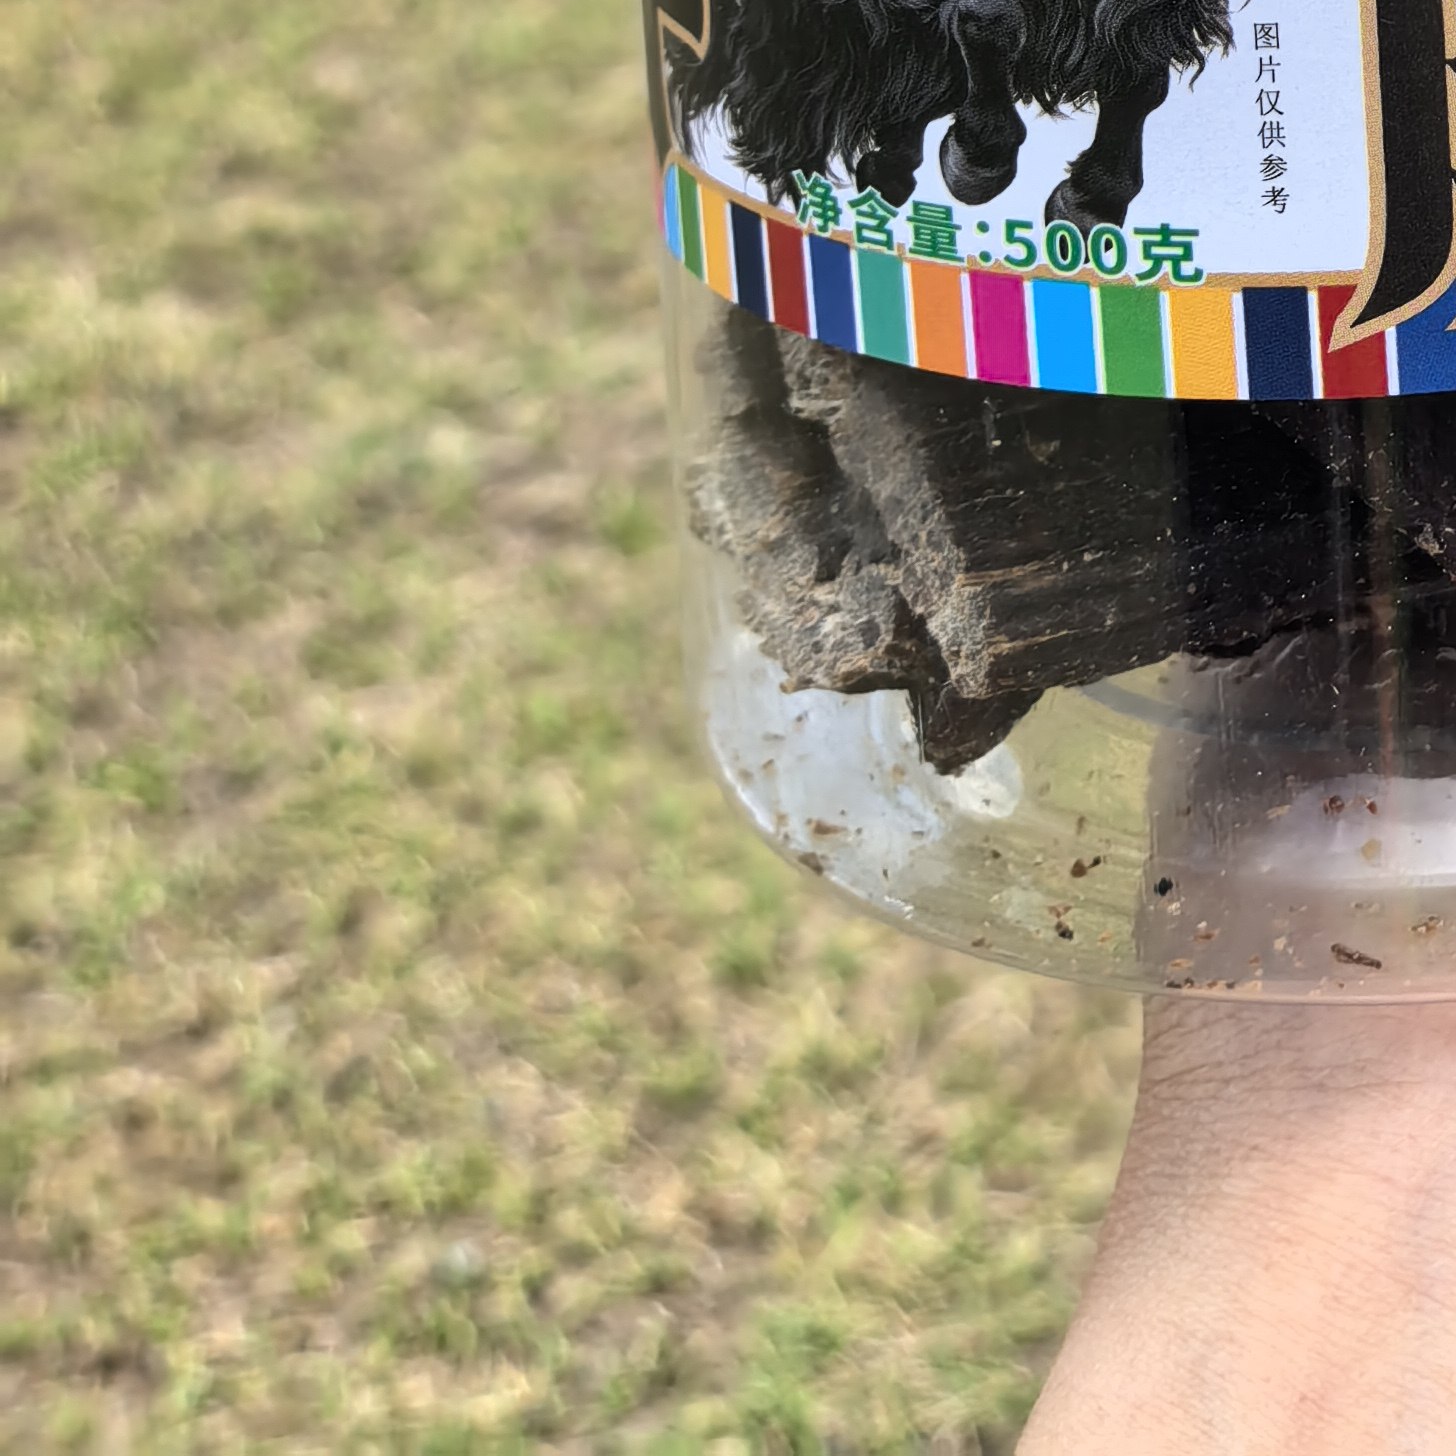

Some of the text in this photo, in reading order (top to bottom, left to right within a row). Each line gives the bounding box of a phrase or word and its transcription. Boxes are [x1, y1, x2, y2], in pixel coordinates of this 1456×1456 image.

[1253, 21, 1290, 215] 图片仅供参考
[792, 169, 1207, 287] 净含量:500克
